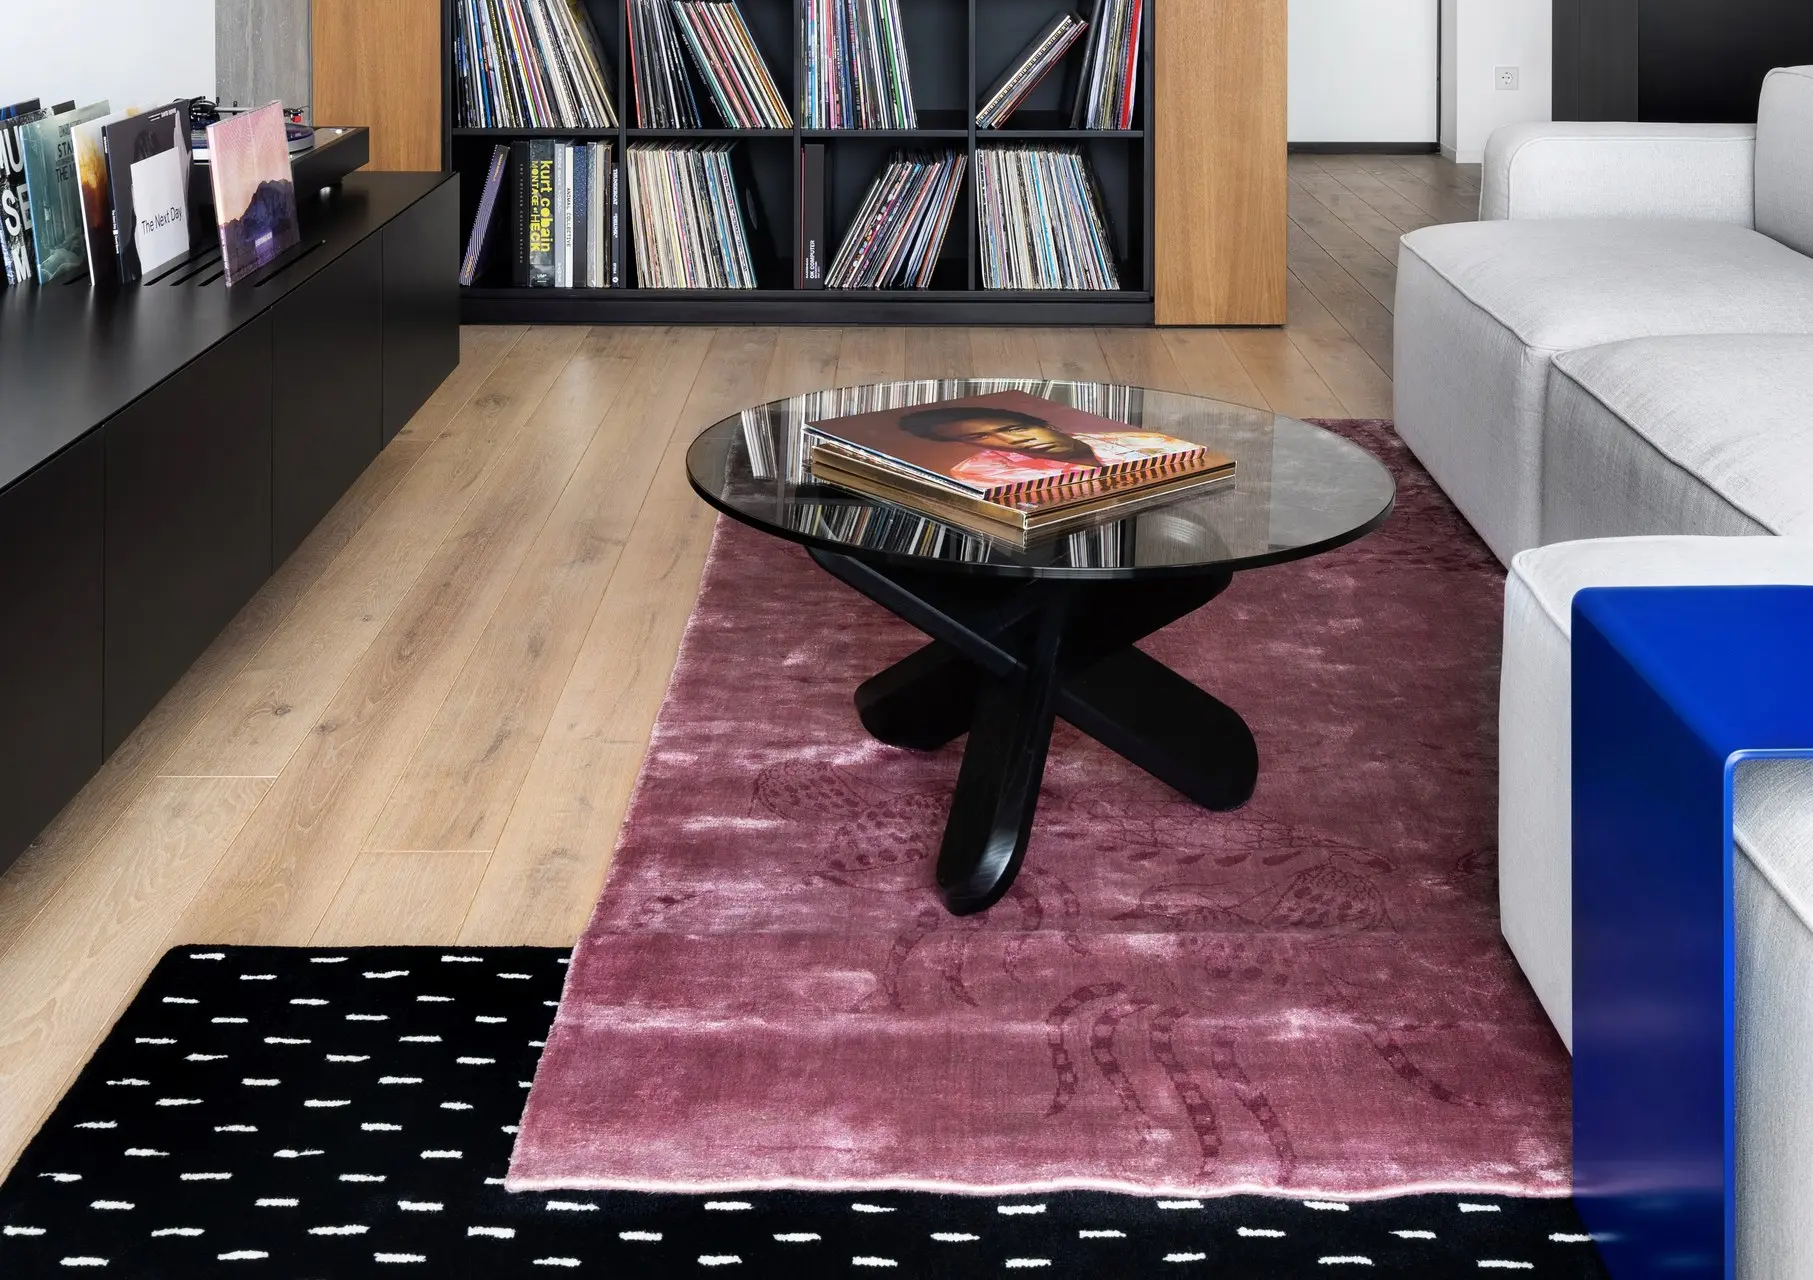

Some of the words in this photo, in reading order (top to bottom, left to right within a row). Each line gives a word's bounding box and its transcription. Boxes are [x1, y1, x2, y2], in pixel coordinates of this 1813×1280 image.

[531, 160, 539, 206] MONTAGE
[540, 160, 553, 193] kurt
[141, 218, 154, 235] The
[155, 212, 170, 229] Next
[170, 206, 183, 223] Day
[530, 214, 541, 252] HECK
[540, 197, 553, 252] cobain
[810, 270, 815, 279] OK
